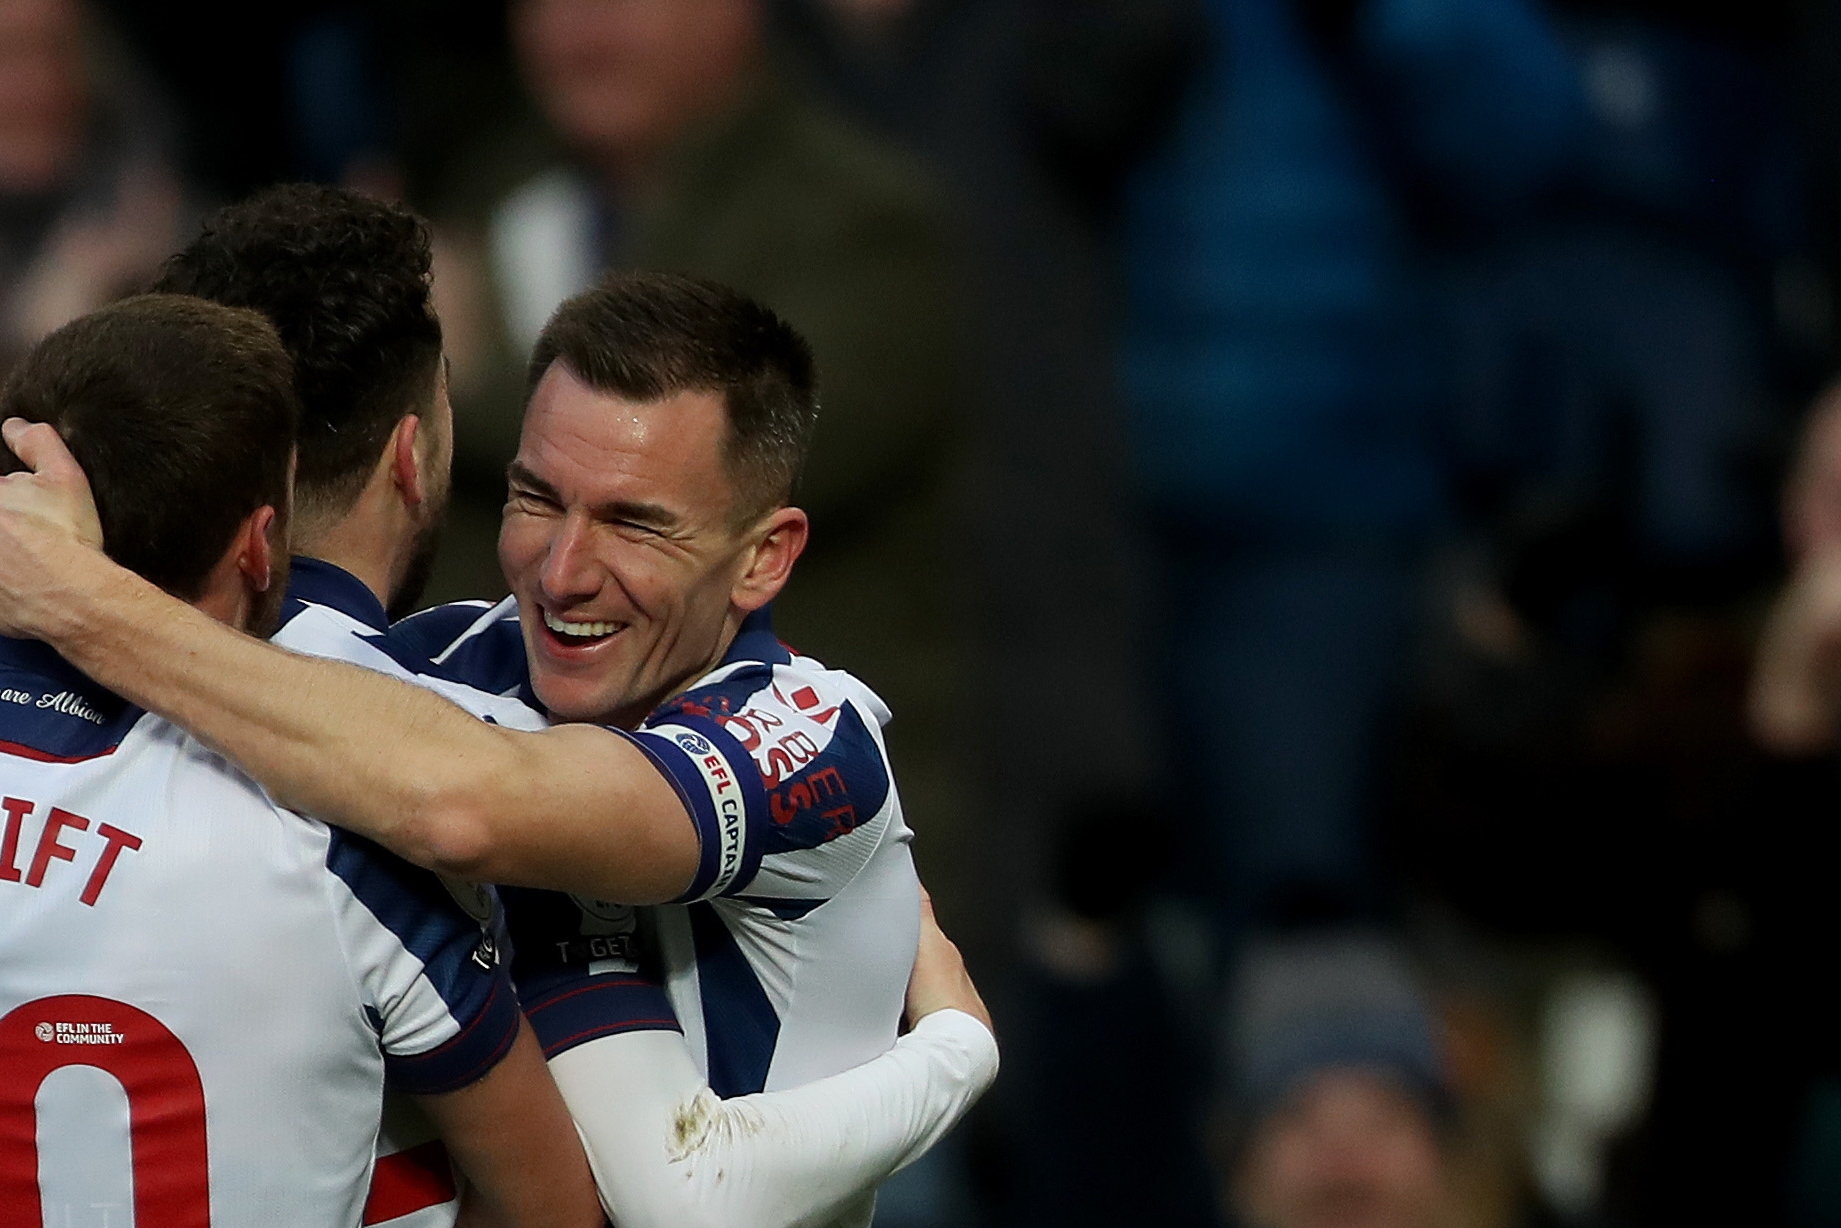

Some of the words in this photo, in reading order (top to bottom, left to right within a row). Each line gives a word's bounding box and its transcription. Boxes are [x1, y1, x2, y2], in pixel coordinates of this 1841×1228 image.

[1, 688, 32, 705] are
[36, 691, 105, 725] Albion
[703, 754, 730, 795] EFL
[55, 1022, 76, 1034] EFL
[76, 1023, 89, 1034] IN
[90, 1023, 113, 1034] THE
[56, 1033, 124, 1045] COMMUNITY
